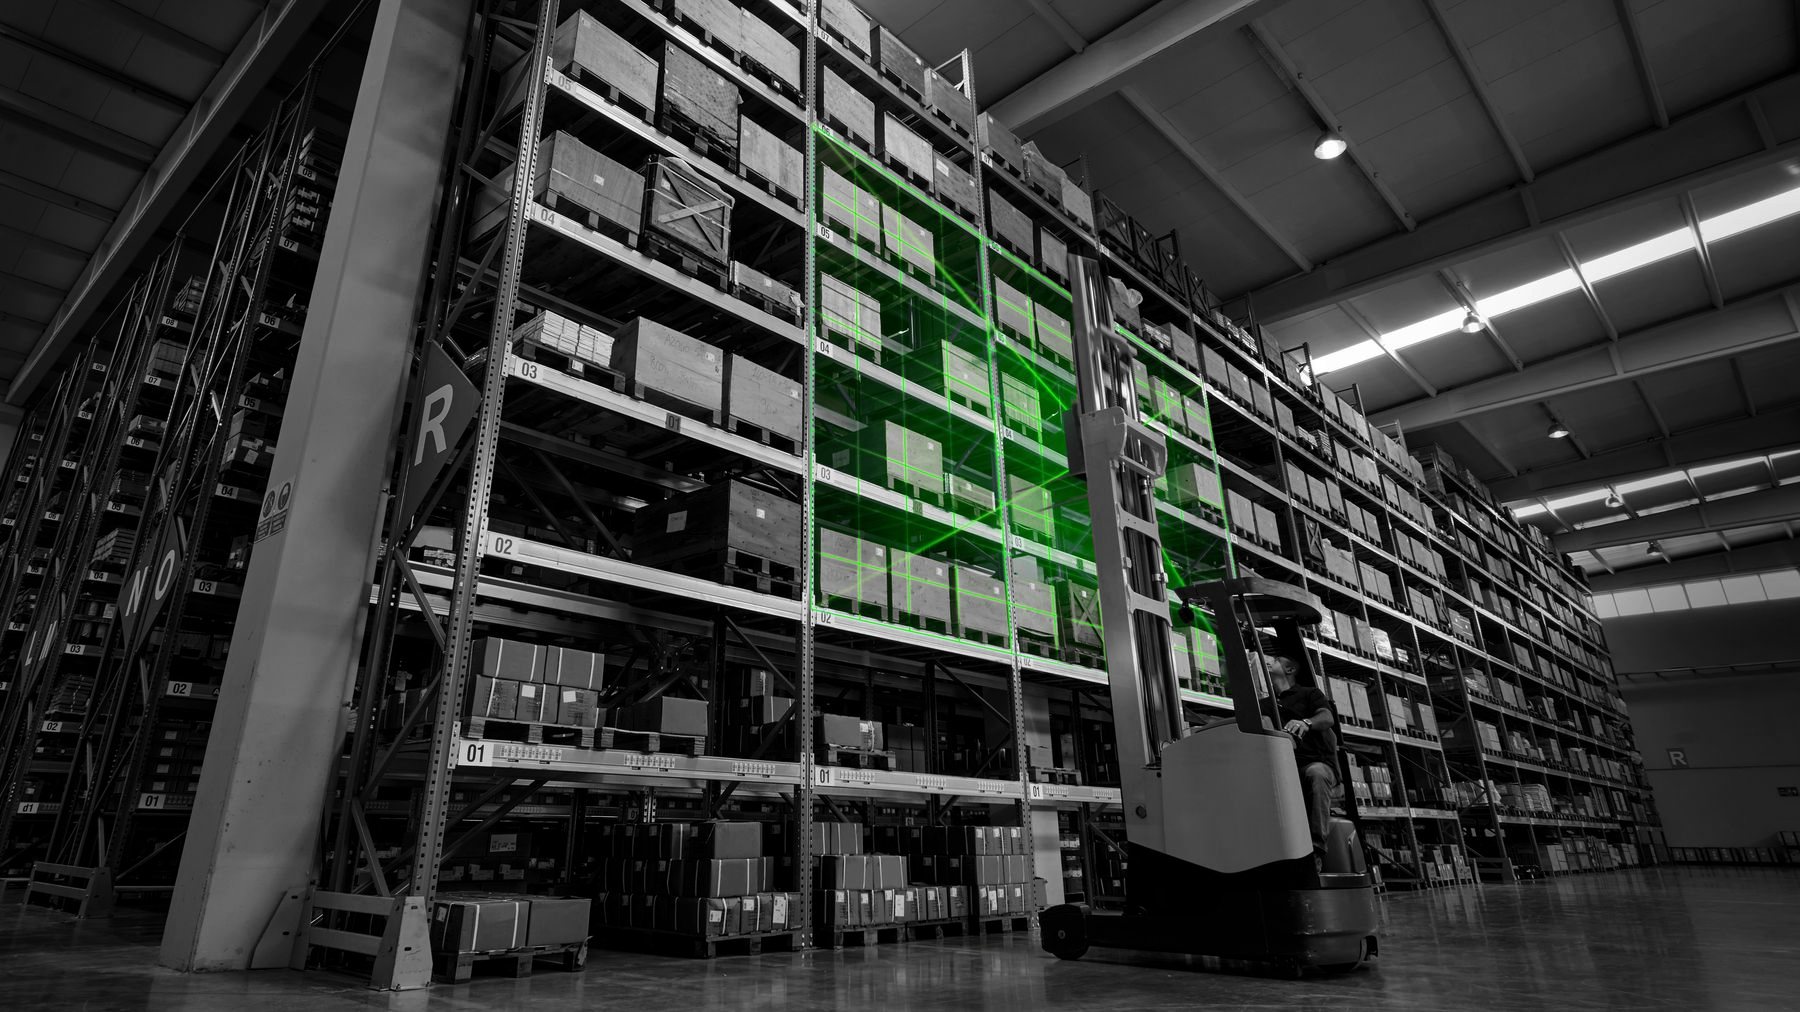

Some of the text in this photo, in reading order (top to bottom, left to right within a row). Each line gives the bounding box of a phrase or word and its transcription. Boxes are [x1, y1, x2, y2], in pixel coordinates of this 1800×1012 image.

[821, 31, 829, 41] 07
[559, 76, 571, 90] 05
[302, 168, 313, 177] 08
[541, 209, 554, 224] 04
[821, 227, 829, 239] 05
[284, 240, 294, 248] 07
[264, 316, 275, 325] 06
[820, 342, 829, 354] 04
[522, 363, 537, 379] 03
[244, 398, 255, 407] 05
[415, 384, 453, 466] R
[669, 416, 679, 430] 01
[1006, 429, 1012, 437] 04
[130, 437, 140, 446] 06
[821, 468, 831, 480] 03
[222, 486, 233, 496] 04
[495, 538, 512, 554] 02
[1015, 538, 1022, 547] 03
[199, 582, 211, 592] 03
[821, 612, 831, 624] 02
[173, 684, 186, 694] 02
[47, 722, 57, 731] 02
[468, 744, 485, 762] 01
[1670, 751, 1687, 765] R
[819, 769, 830, 783] 01
[1032, 786, 1040, 797] 01
[145, 796, 159, 806] 01
